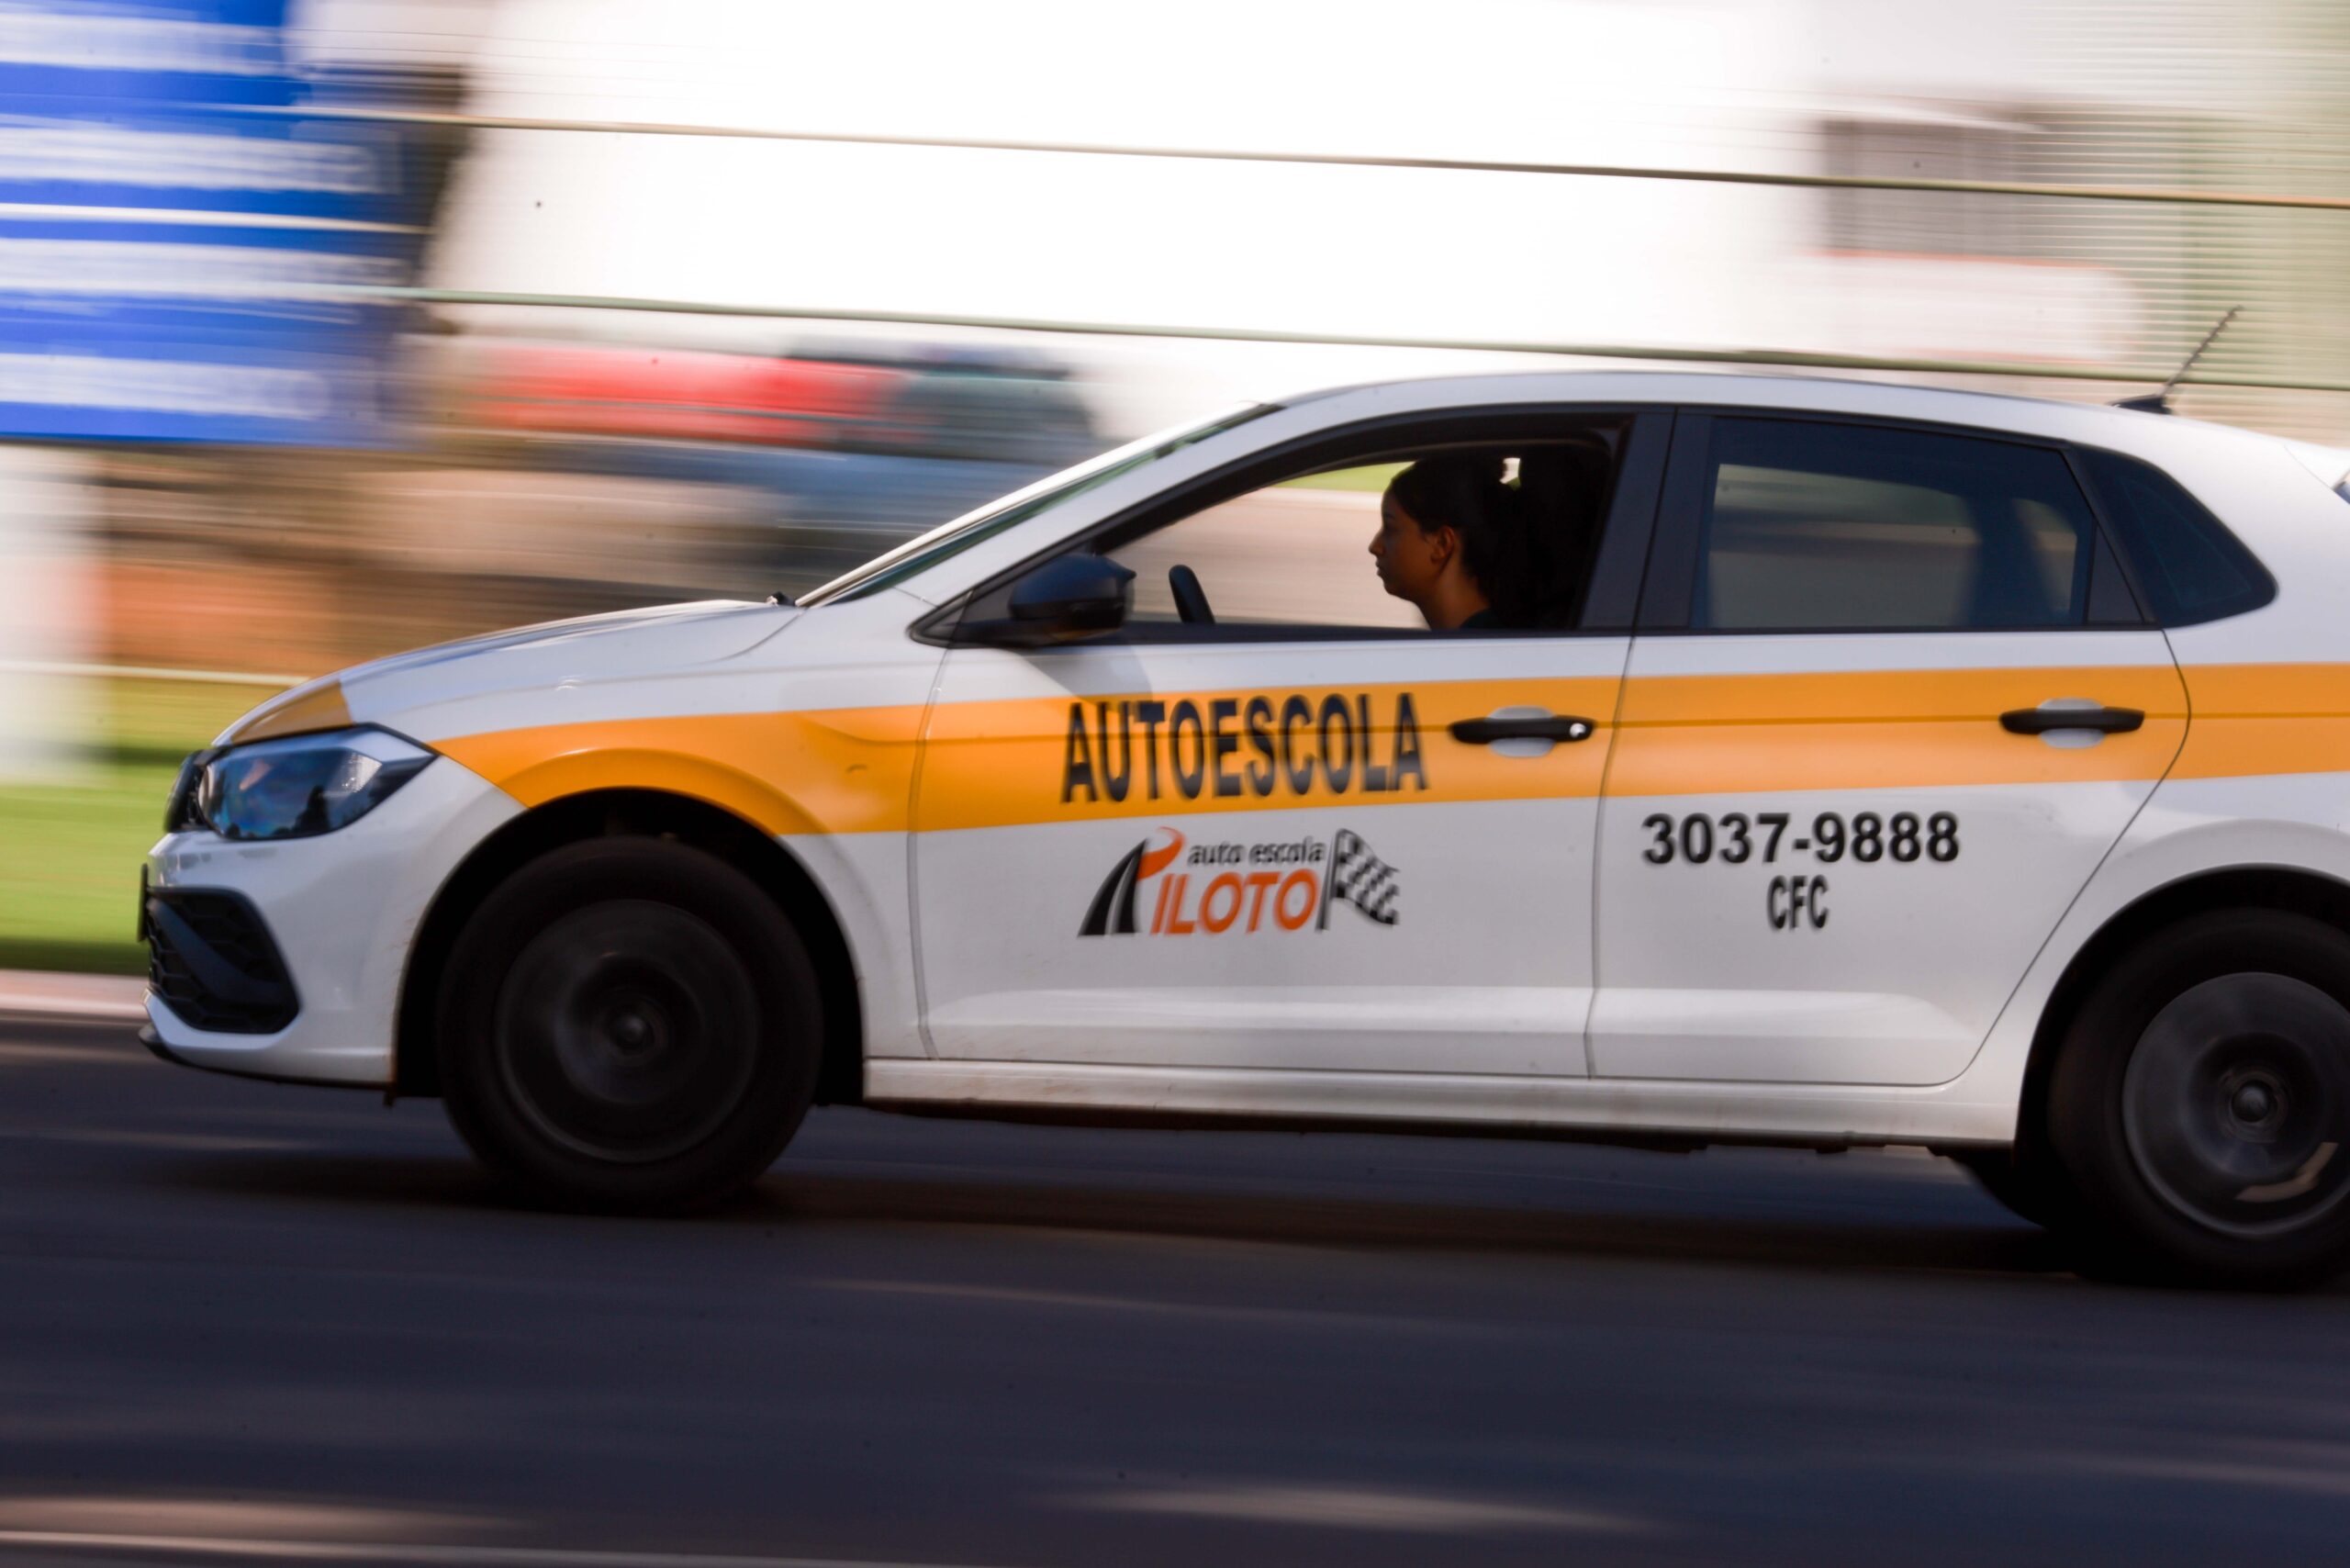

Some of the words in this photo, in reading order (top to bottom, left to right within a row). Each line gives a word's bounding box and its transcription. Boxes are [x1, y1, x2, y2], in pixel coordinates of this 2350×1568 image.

[1060, 692, 1429, 803] AUTOESCOLA
[1187, 841, 1244, 864] auto
[1249, 836, 1326, 863] escola
[1640, 811, 1960, 865] 3037-9888
[1078, 826, 1319, 937] PILOTO
[1766, 874, 1830, 930] CFC
